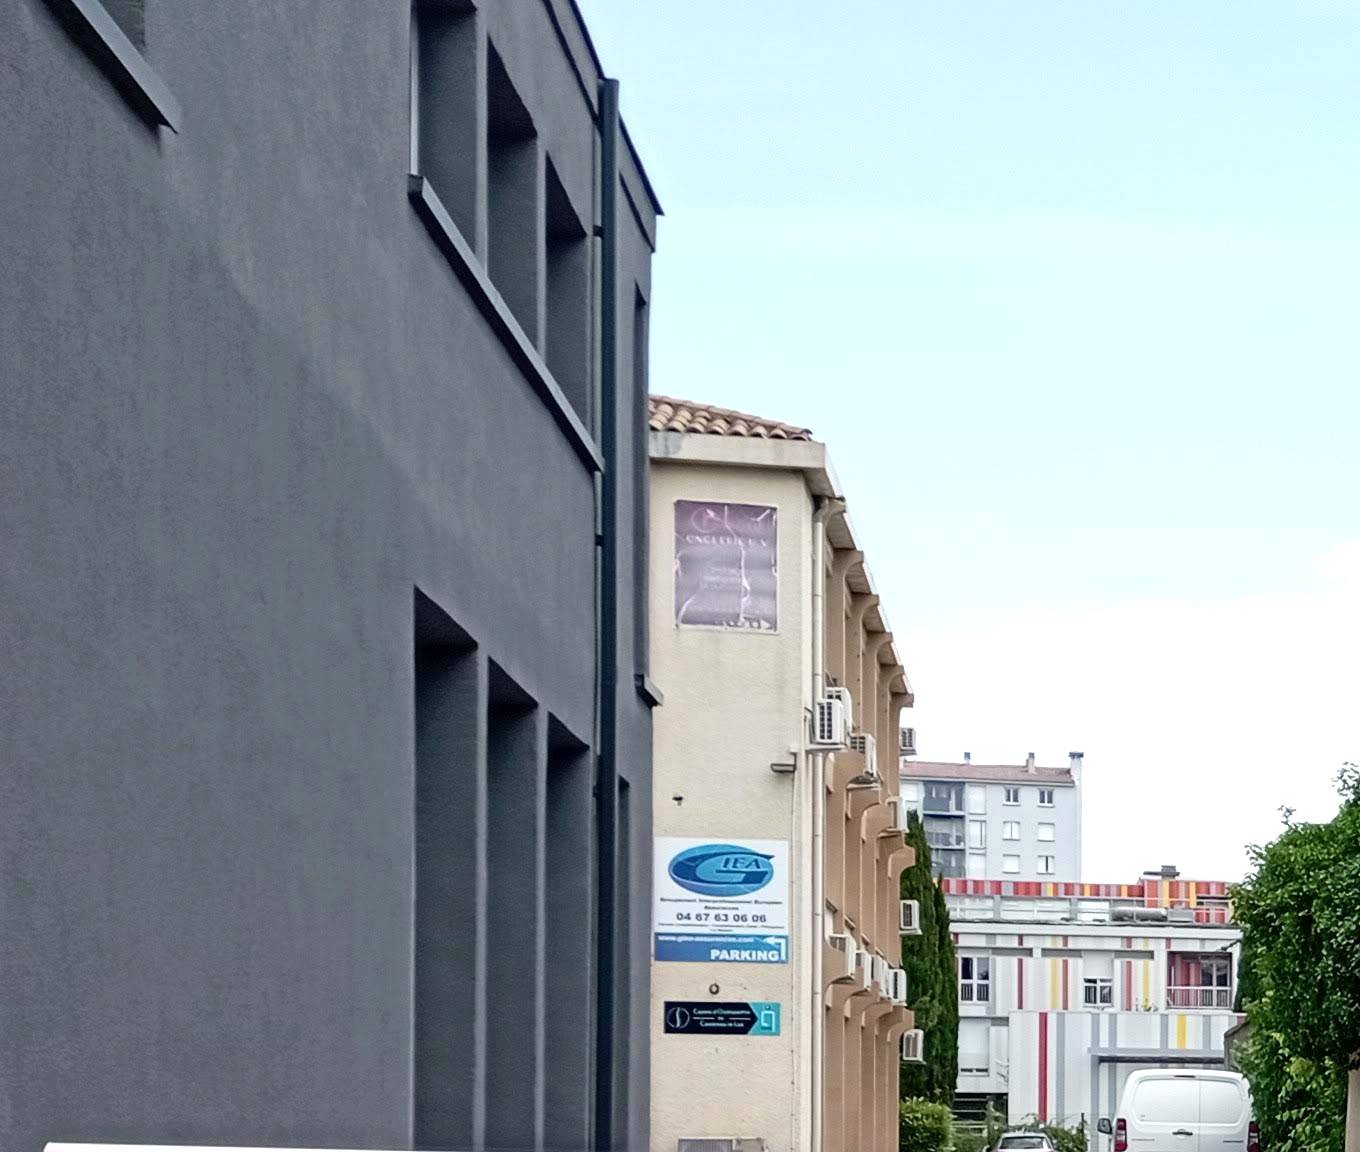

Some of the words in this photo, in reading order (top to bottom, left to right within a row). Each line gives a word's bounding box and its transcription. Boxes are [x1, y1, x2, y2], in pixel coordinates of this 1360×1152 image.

[676, 912, 691, 921] 04
[695, 913, 710, 921] 67
[714, 913, 729, 922] 63
[733, 914, 748, 923] 06
[751, 914, 767, 923] 06
[710, 949, 780, 961] PARKING
